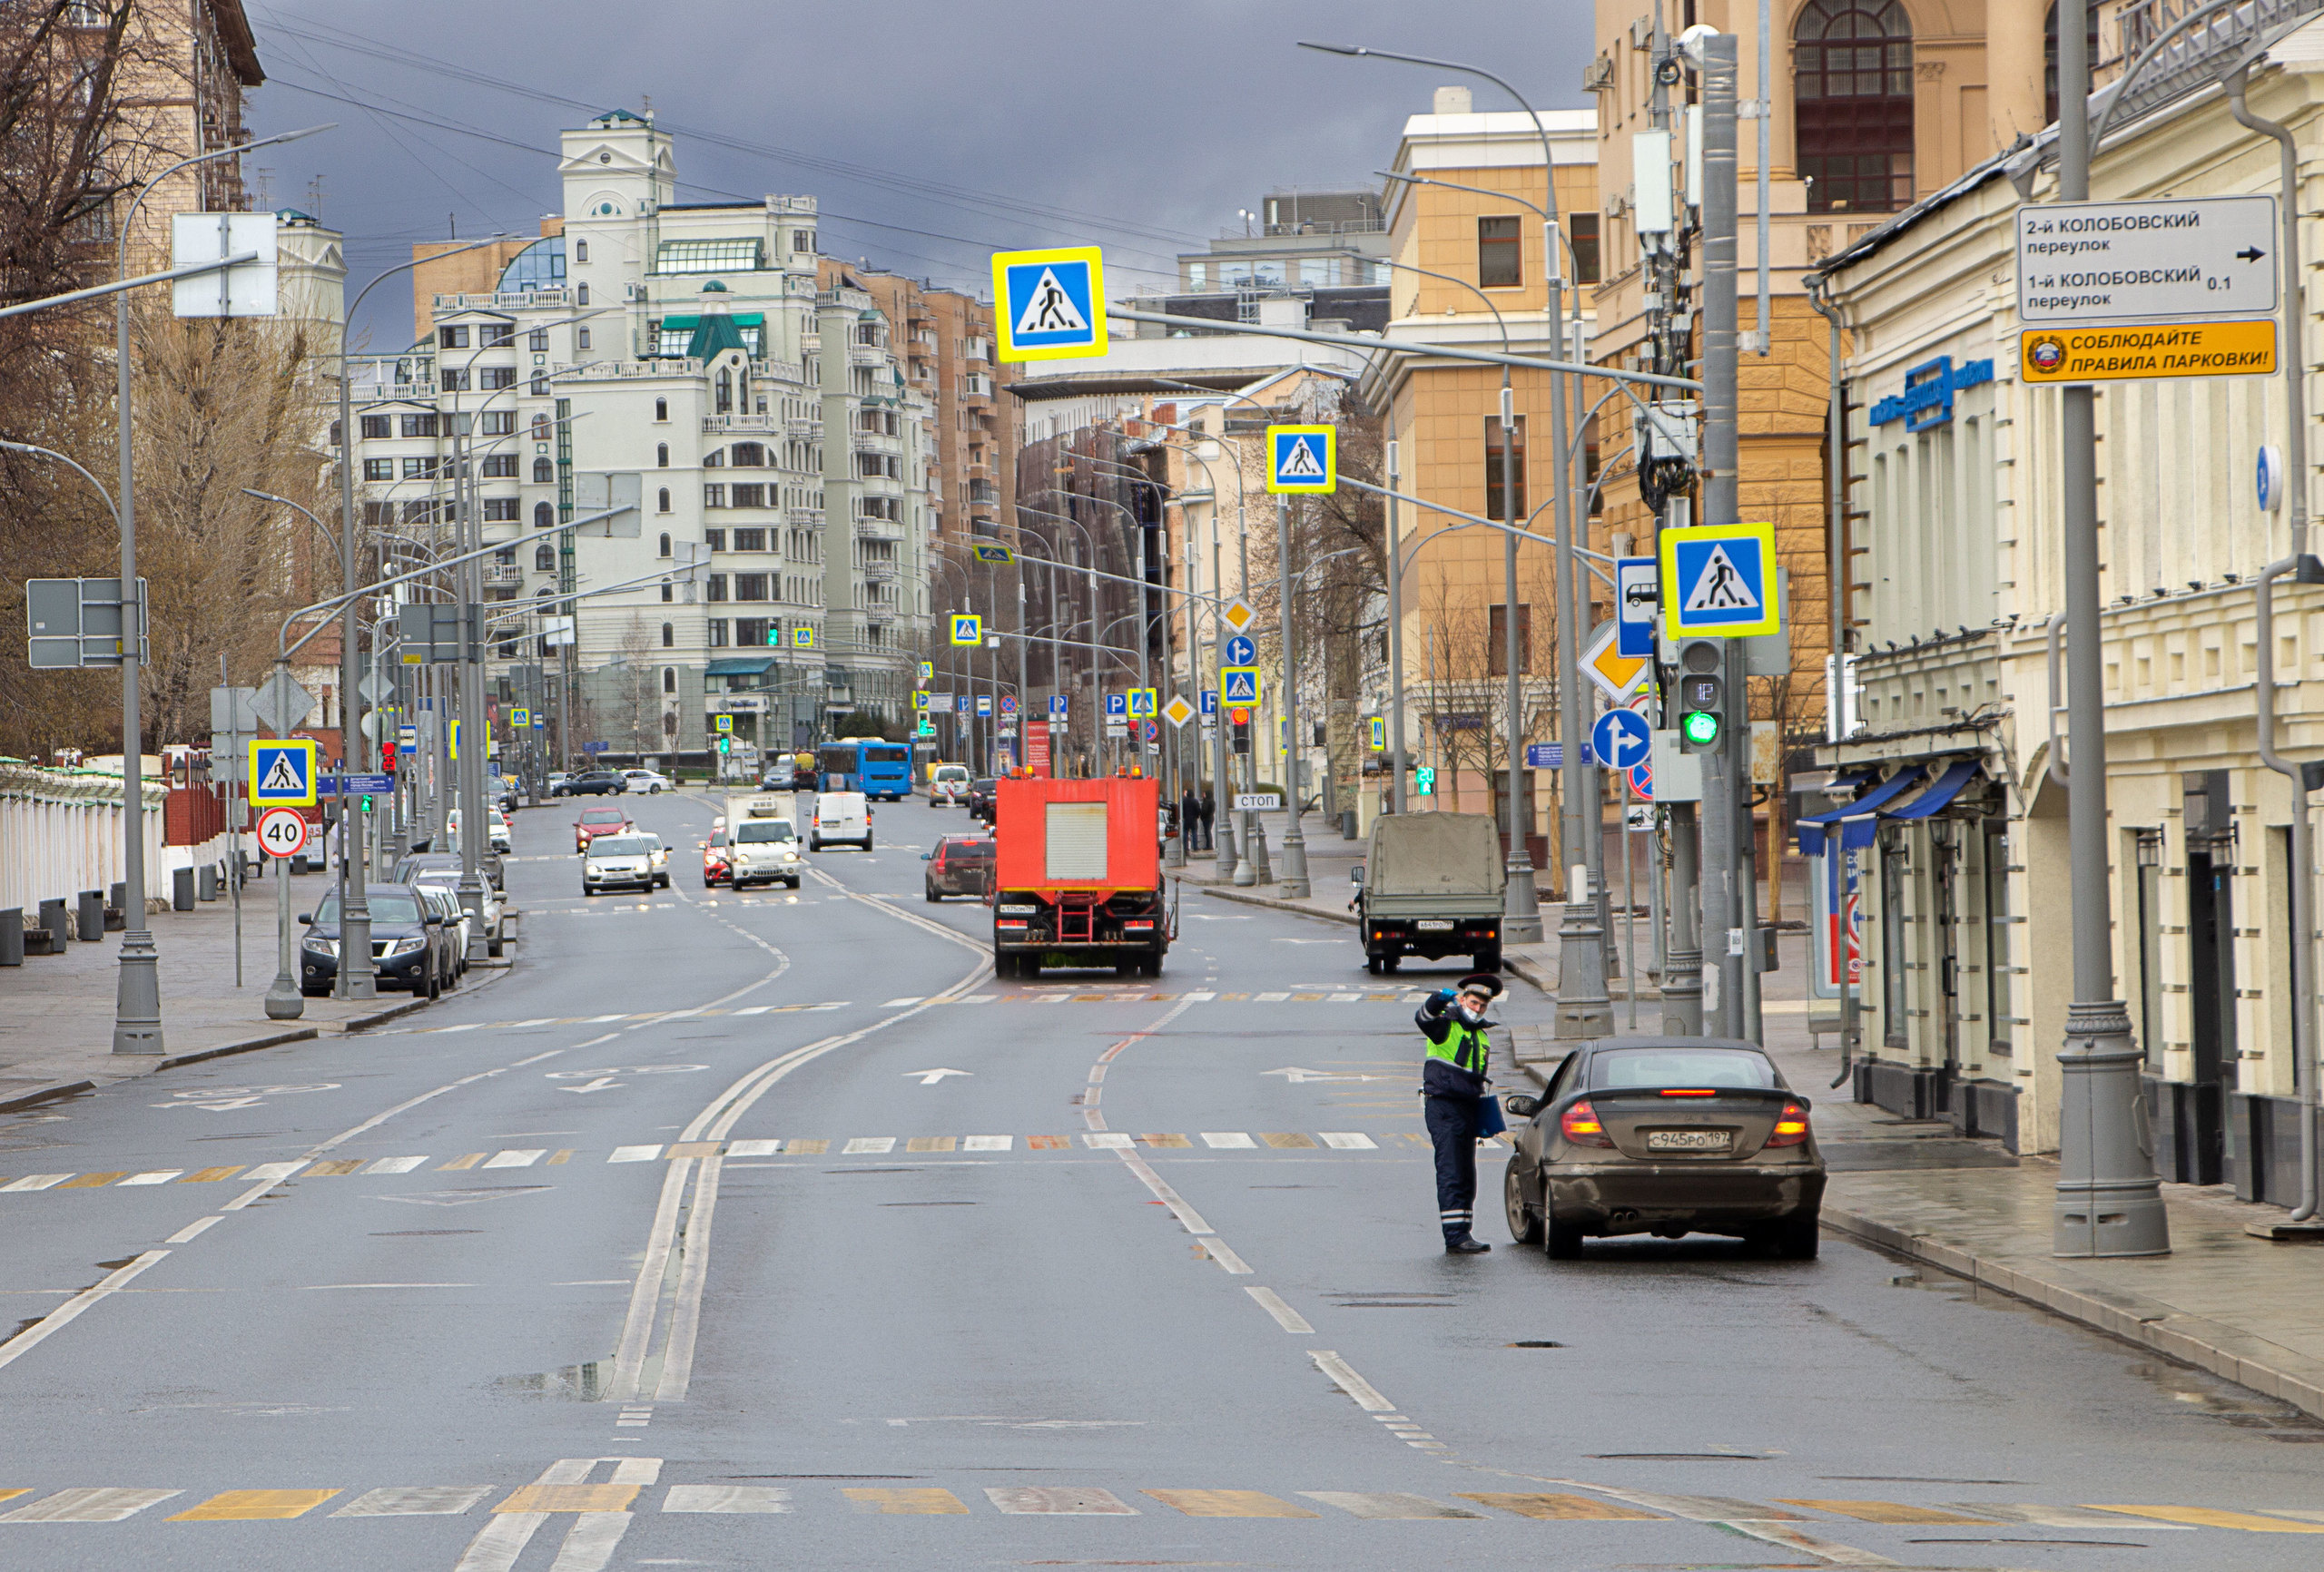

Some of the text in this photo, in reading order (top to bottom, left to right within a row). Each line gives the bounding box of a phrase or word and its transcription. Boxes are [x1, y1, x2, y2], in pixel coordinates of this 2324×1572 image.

[2027, 211, 2201, 234] 2-й КОЛОБОВСКИЙ
[2027, 239, 2111, 255] переулок
[2028, 266, 2201, 290] 1-й КОЛОБОВСКИЙ
[2207, 276, 2231, 290] 0.1
[2027, 294, 2112, 309] переулок
[2071, 329, 2203, 350] СОБЛЮДАЙТЕ
[2070, 350, 2269, 373] ПРАВИЛА ПАРКОВКИ!
[1419, 768, 1434, 781] 20
[1241, 796, 1275, 807] СТОП
[267, 822, 298, 842] 40
